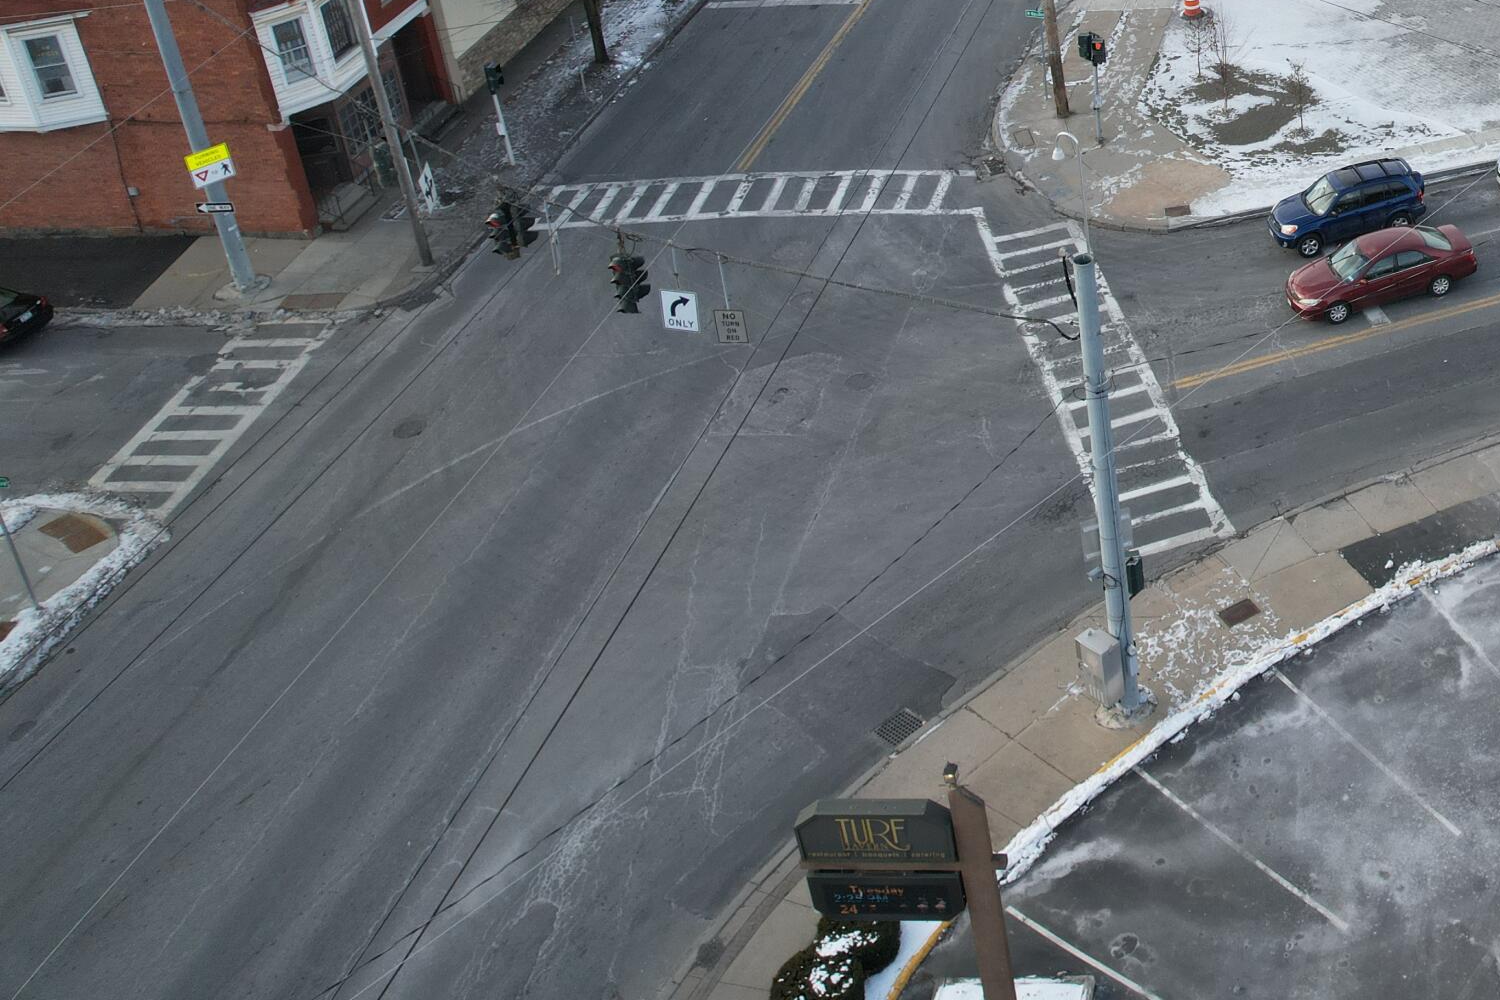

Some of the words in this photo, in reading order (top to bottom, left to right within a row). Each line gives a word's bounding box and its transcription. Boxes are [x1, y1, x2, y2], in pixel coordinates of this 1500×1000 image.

[668, 318, 695, 328] ONLY
[835, 818, 911, 851] TURF
[840, 904, 858, 914] 24
